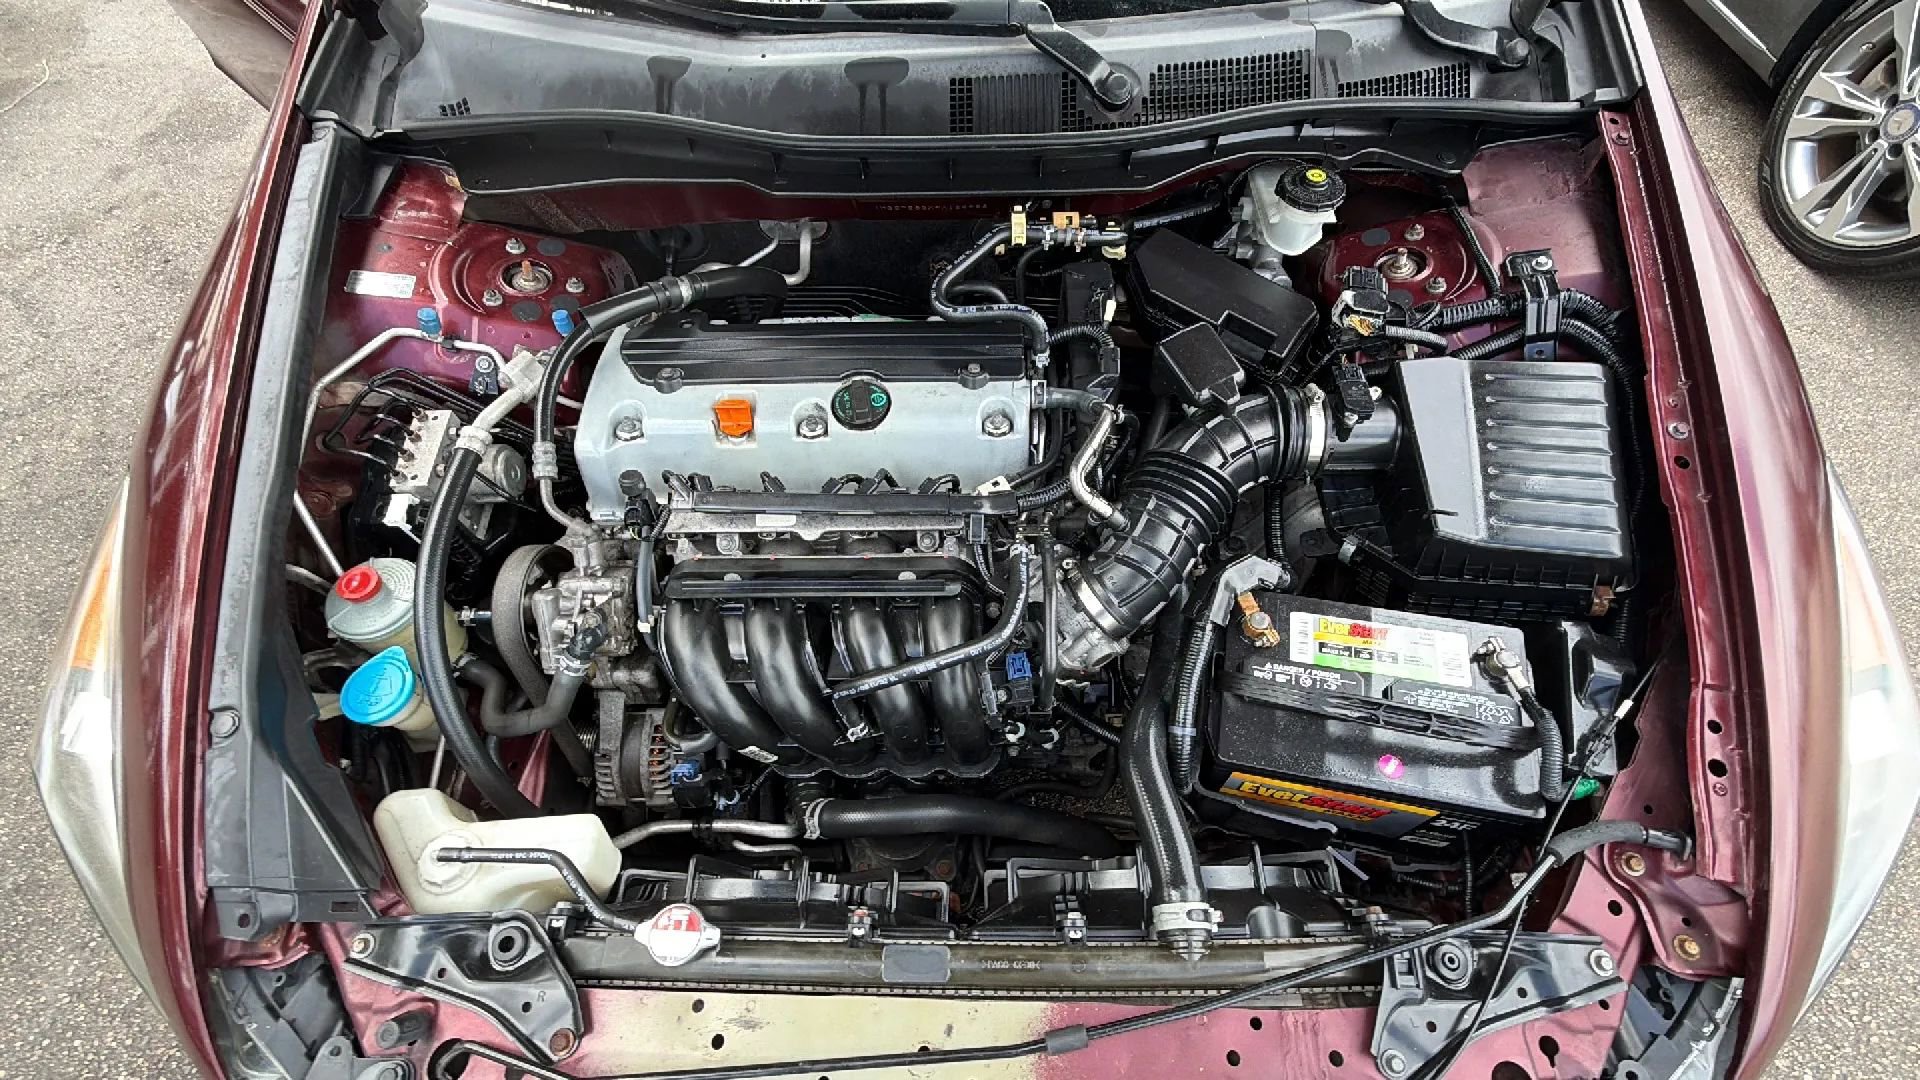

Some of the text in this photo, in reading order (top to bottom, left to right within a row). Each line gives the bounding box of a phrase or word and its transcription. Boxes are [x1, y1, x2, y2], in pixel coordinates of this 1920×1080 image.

[1319, 618, 1388, 639] EverStart
[1273, 663, 1305, 674] DANGER
[1240, 781, 1392, 818] EverStart
[537, 991, 546, 1002] R
